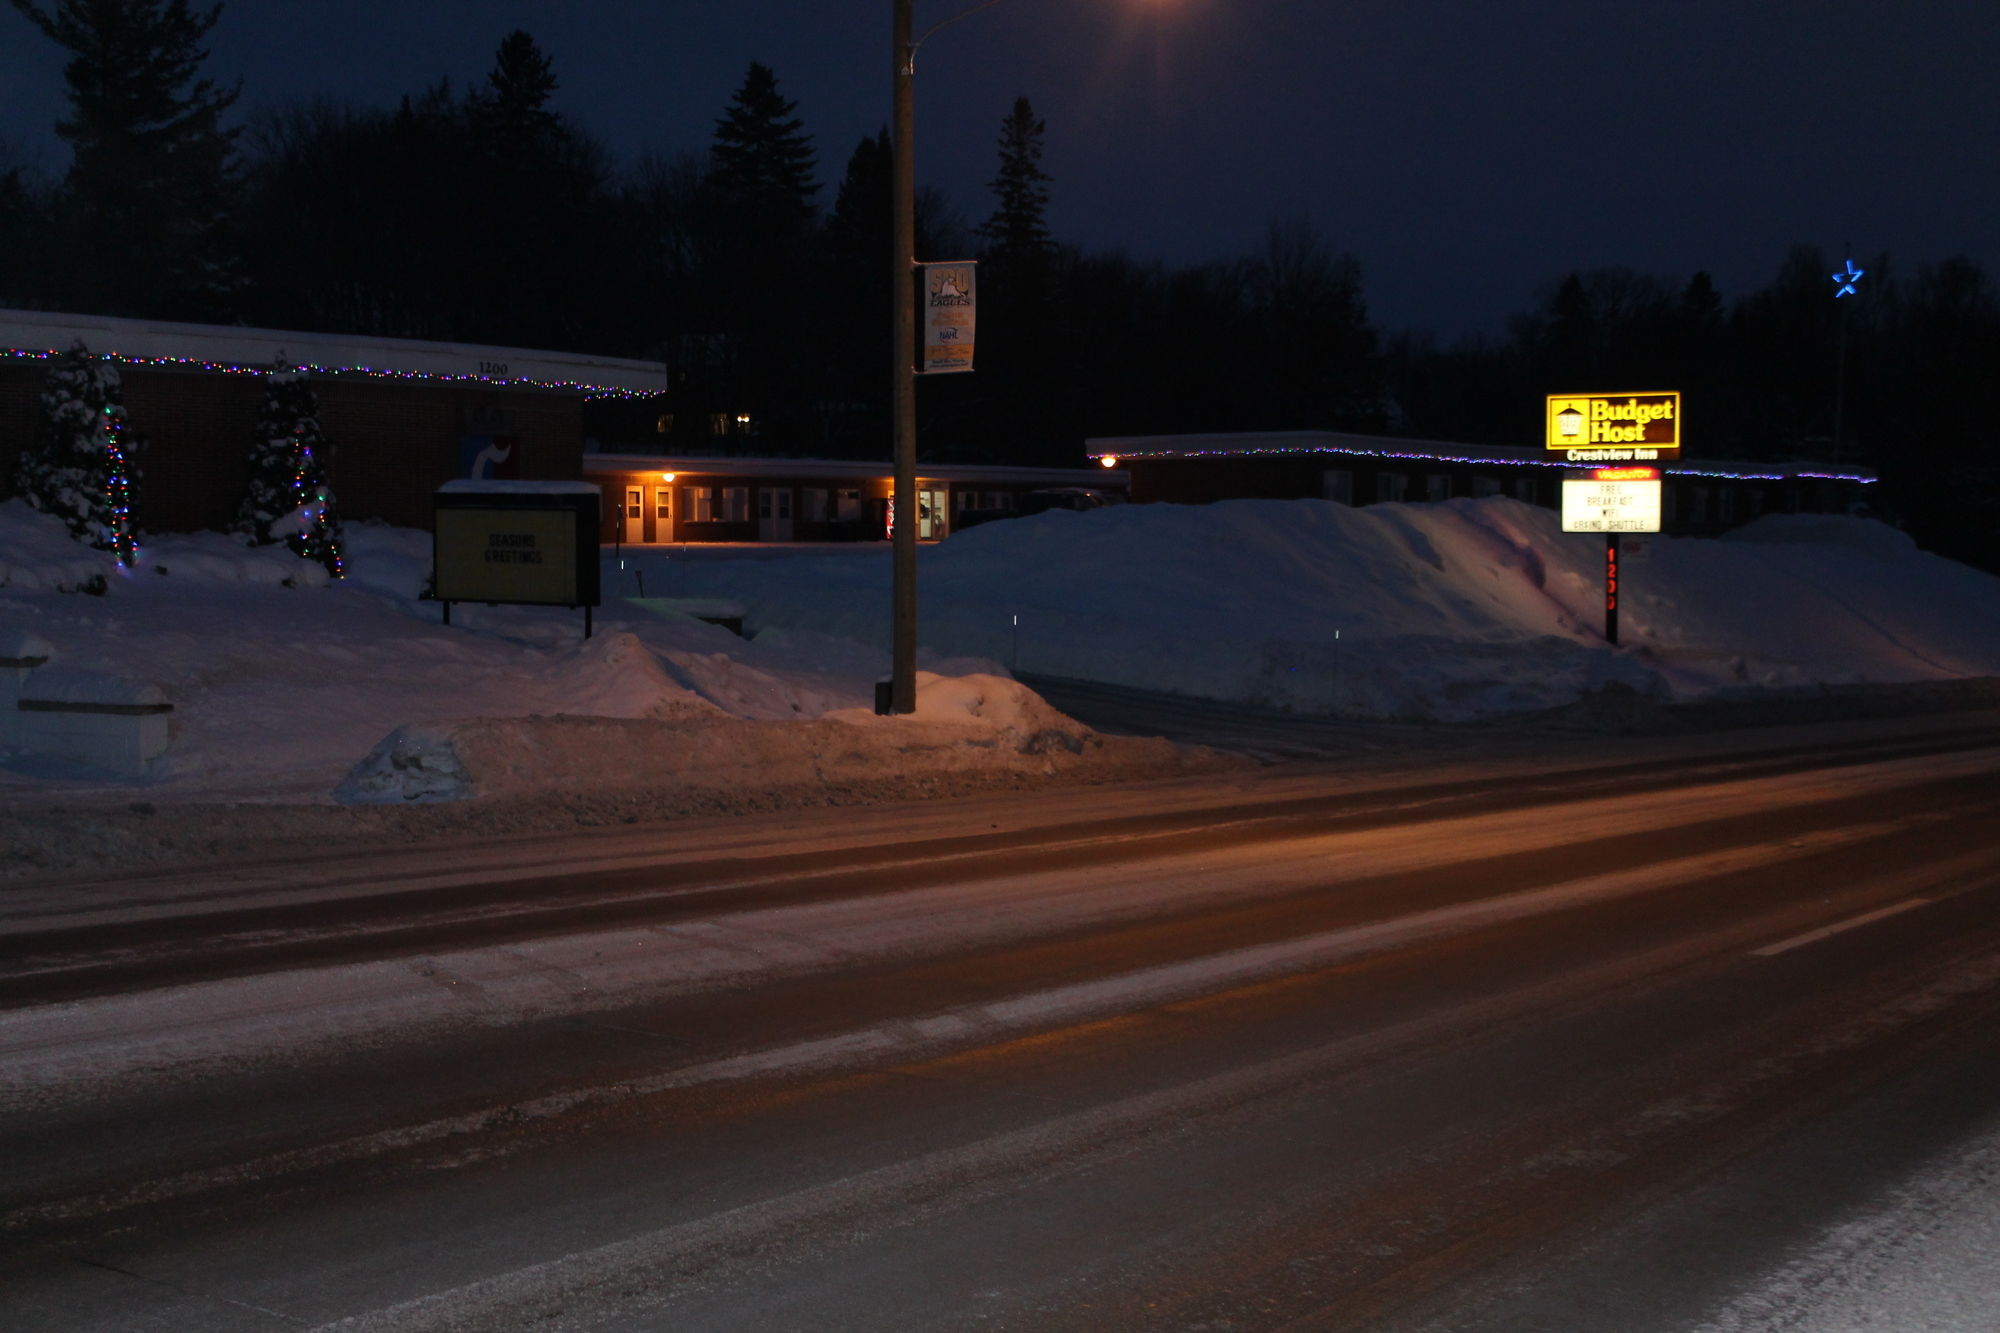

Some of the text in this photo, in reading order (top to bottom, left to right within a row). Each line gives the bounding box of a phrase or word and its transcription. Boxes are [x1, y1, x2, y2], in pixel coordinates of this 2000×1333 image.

[480, 361, 508, 375] 1200
[1590, 398, 1674, 424] Budget
[1590, 420, 1646, 443] Host
[1566, 449, 1658, 461] Crestview Inn
[1608, 520, 1645, 530] SHUTTLE
[488, 534, 536, 547] SEASONS
[485, 550, 542, 563] GREETINGS
[1606, 546, 1618, 610] 1200
